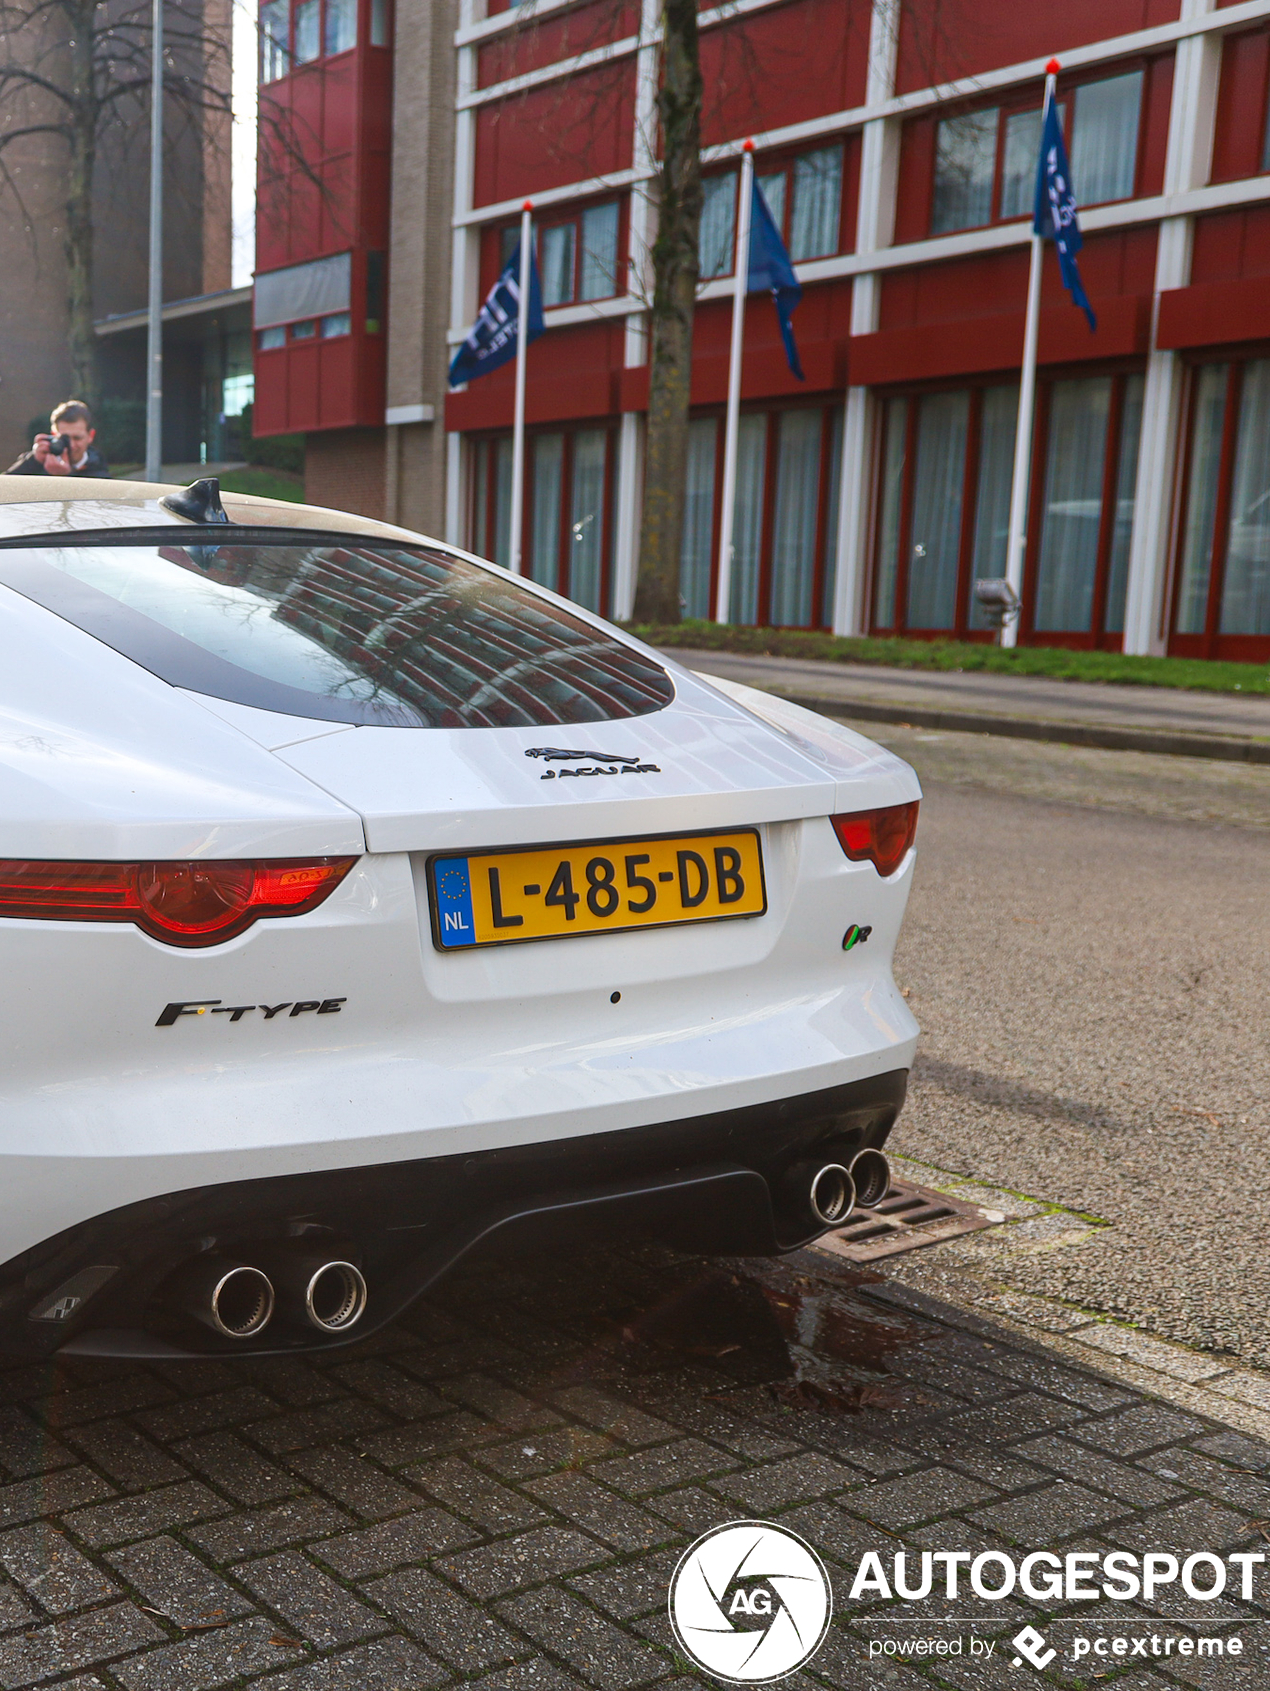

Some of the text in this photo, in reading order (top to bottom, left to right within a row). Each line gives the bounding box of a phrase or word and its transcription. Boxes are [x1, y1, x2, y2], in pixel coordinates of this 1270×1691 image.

[540, 764, 662, 780] JAGUAR
[487, 846, 746, 928] L-485-DB
[444, 912, 469, 931] NL
[154, 997, 348, 1027] F-TYPE
